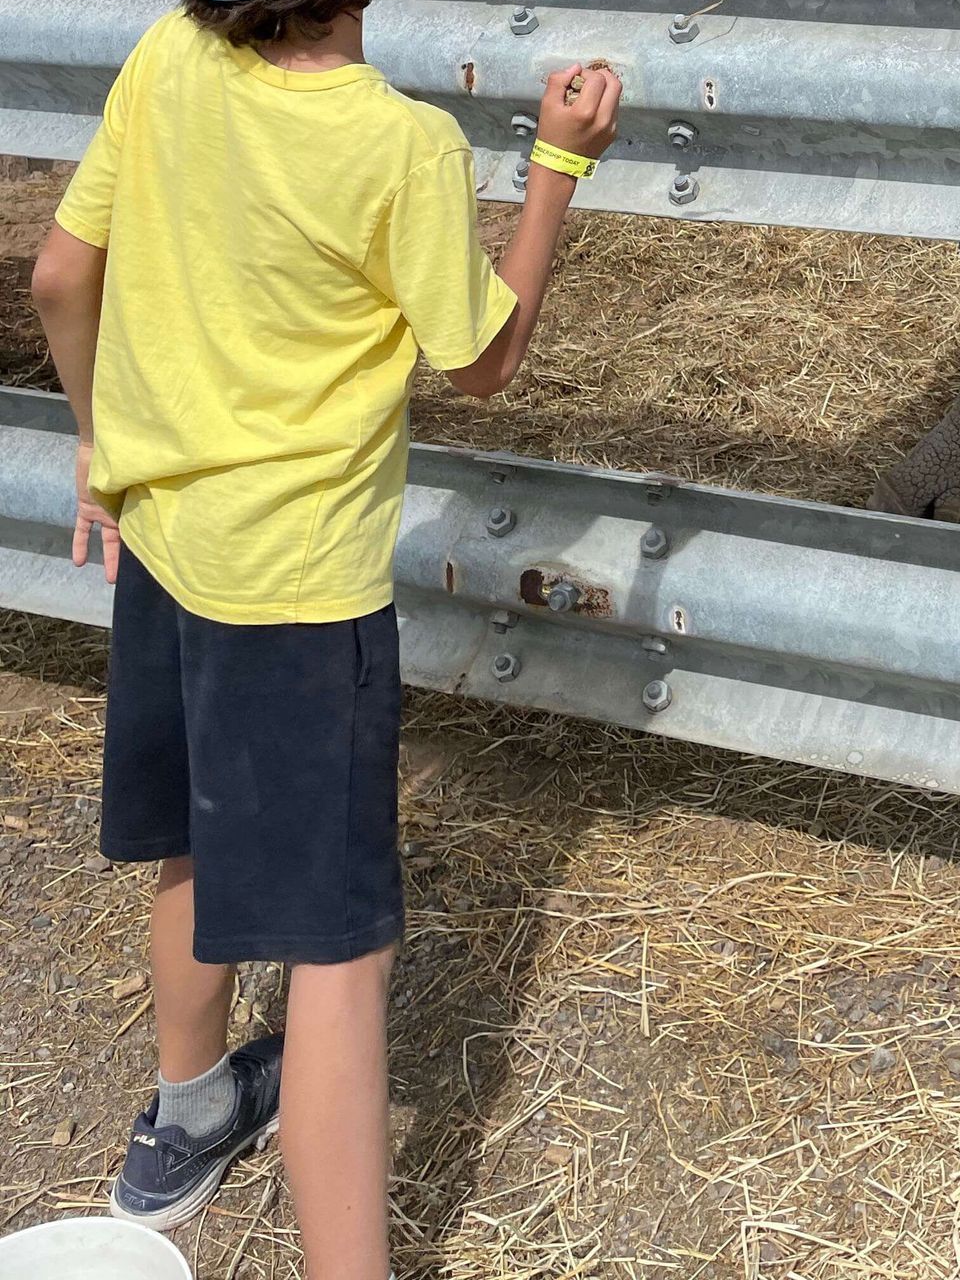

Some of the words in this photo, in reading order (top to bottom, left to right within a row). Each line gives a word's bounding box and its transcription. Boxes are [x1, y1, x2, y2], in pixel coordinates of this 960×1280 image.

[534, 145, 562, 160] EMBERSHIP
[562, 157, 581, 166] TODAY
[133, 1134, 156, 1147] FILA
[123, 1192, 146, 1210] FILA
